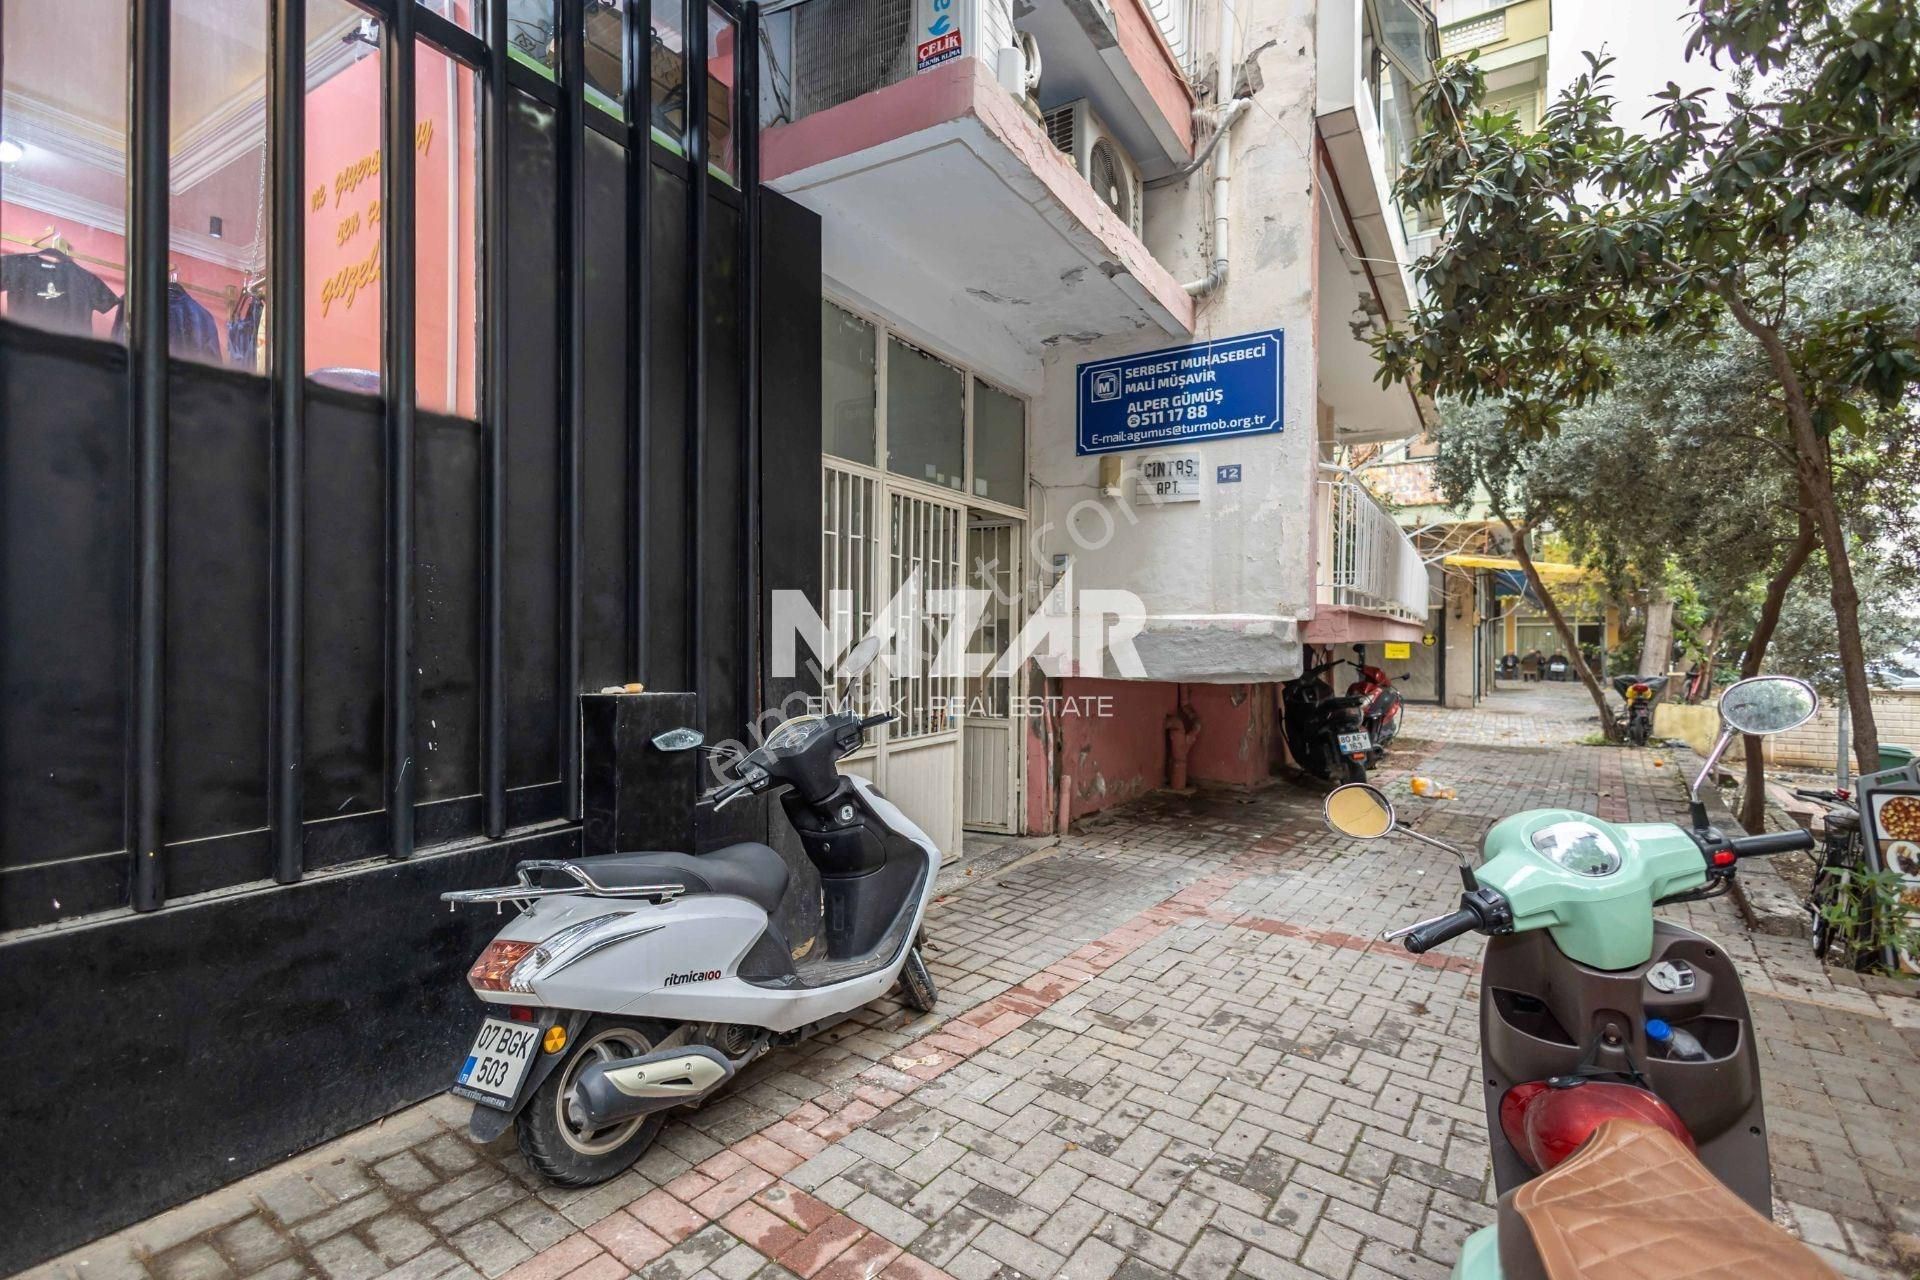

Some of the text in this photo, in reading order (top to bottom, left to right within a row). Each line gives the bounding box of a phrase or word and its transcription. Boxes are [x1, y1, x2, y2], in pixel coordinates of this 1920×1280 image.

[919, 34, 959, 62] ÇELİK
[1125, 343, 1266, 379] SERBEST MUHASEBECİ
[1124, 370, 1217, 395] MALİ MÜŞAVİR
[1127, 388, 1224, 414] ALPER GÜMÜŞ
[1140, 404, 1208, 426] 511 17 88
[1091, 414, 1266, 445] E-mail:agumus@turmob.org.tr
[1219, 467, 1239, 480] 12
[1156, 480, 1181, 495] APT.
[663, 970, 722, 987] ritmica100
[478, 1024, 535, 1060] 07 BGK
[476, 1056, 509, 1087] 503
